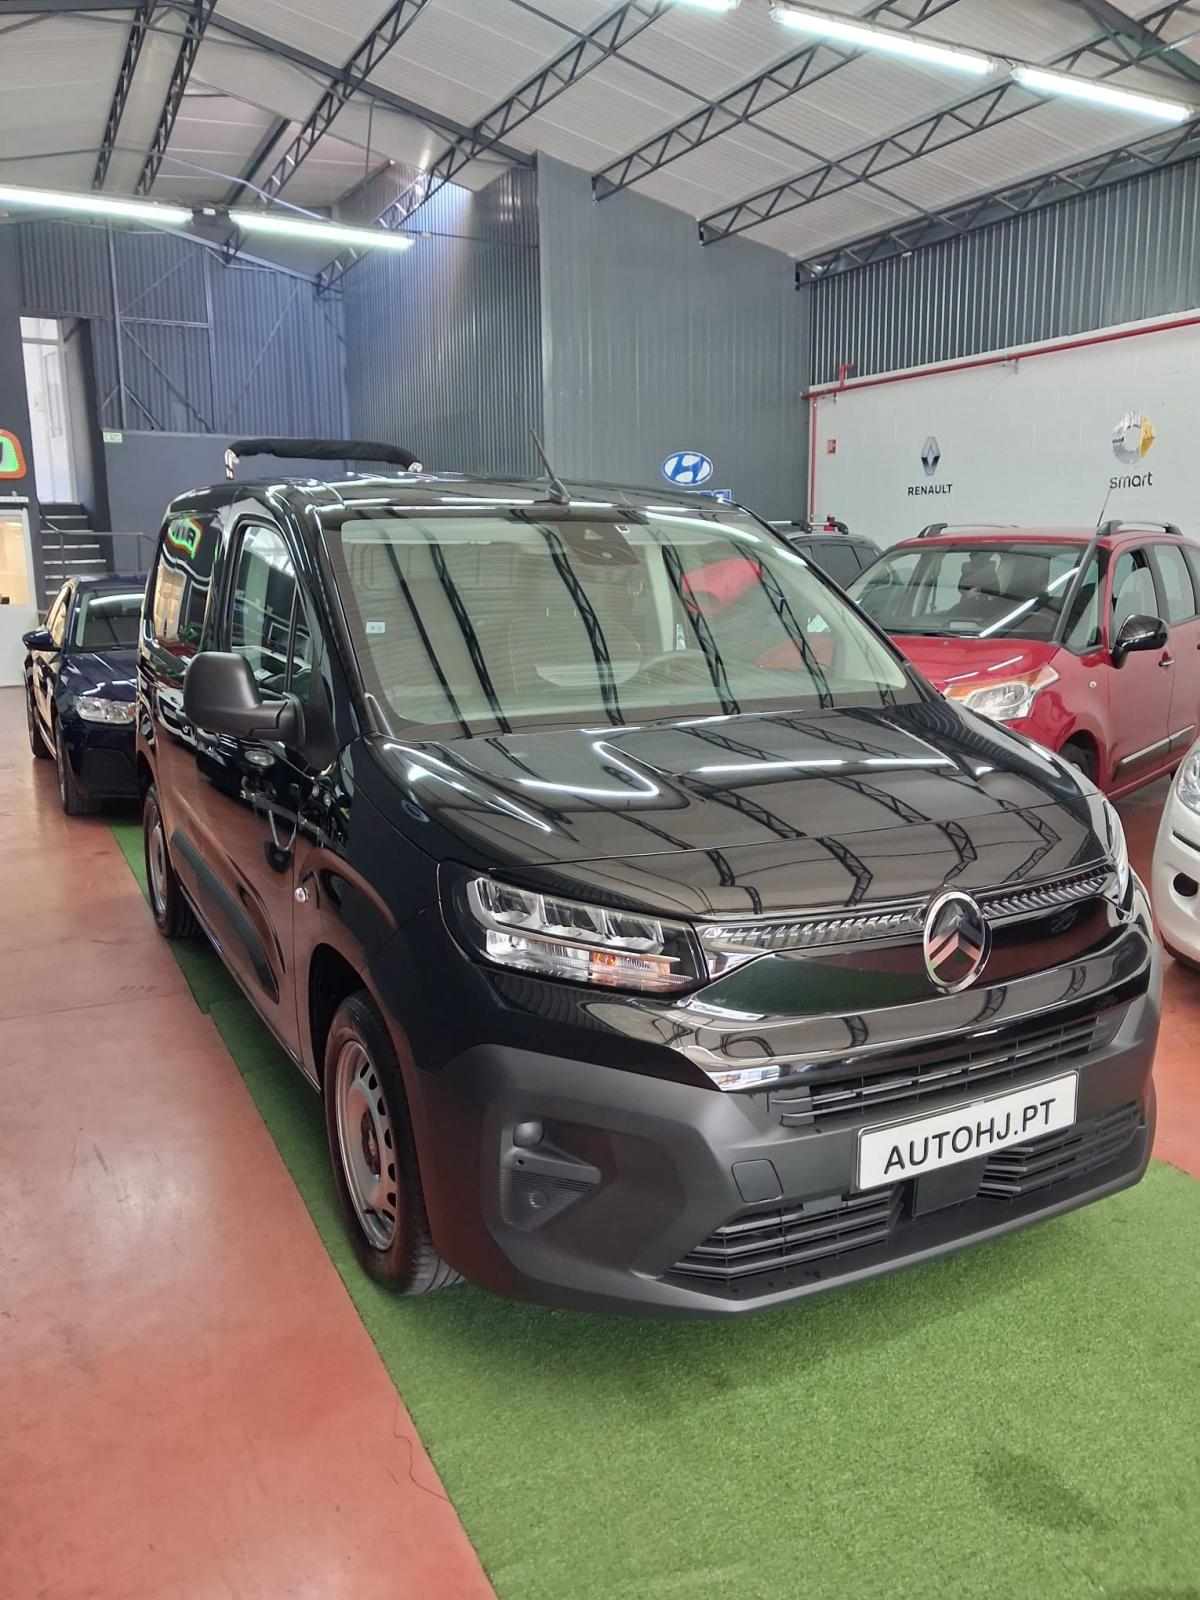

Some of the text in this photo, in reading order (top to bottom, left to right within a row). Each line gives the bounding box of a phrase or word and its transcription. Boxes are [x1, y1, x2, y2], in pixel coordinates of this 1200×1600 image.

[1109, 472, 1153, 488] smart
[907, 484, 953, 496] RENAULT
[884, 1098, 1056, 1175] AUTOHJ.PT
